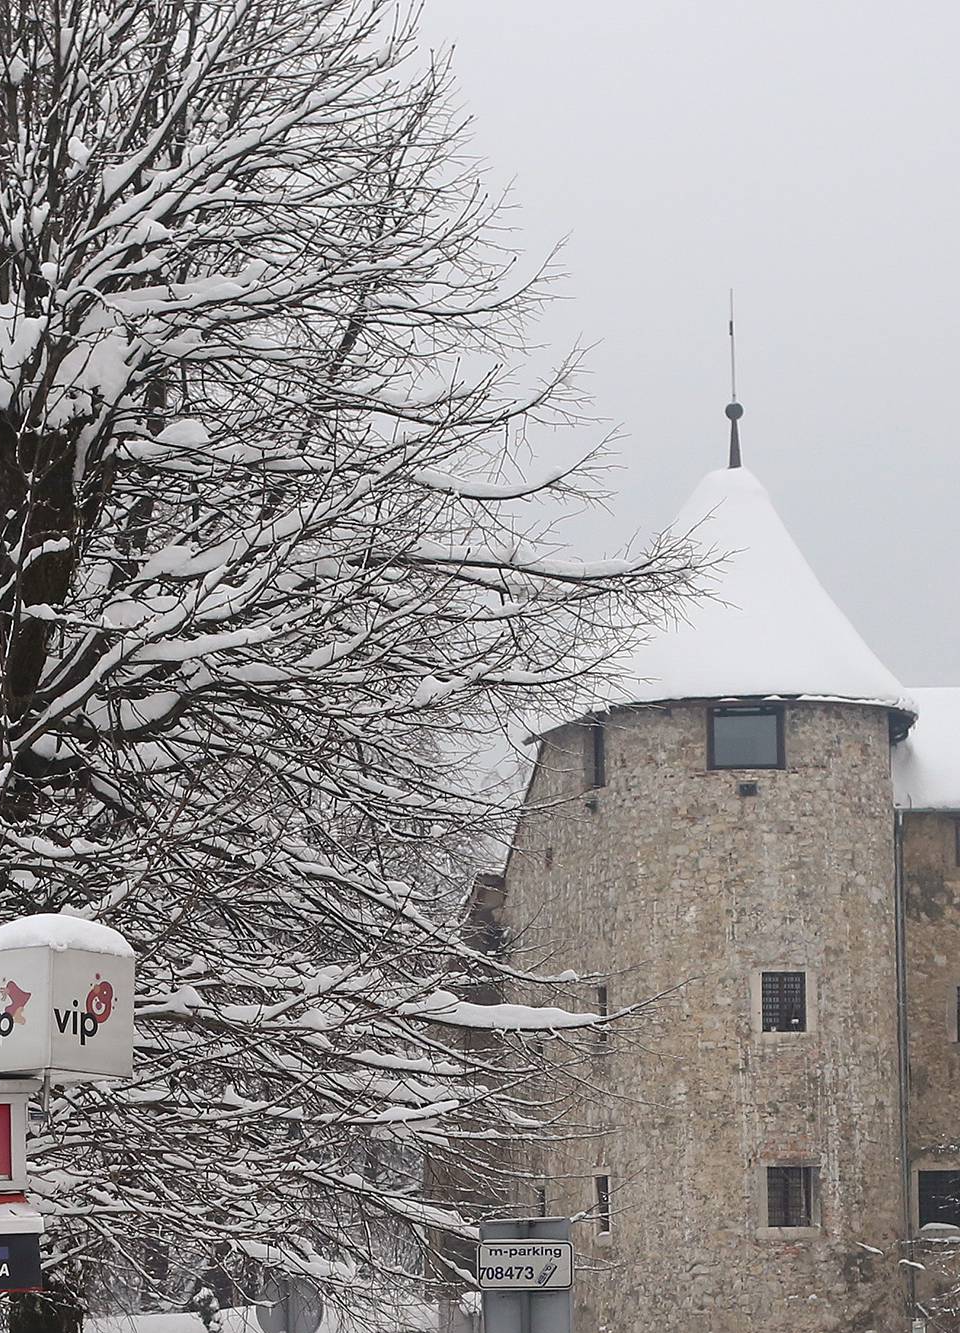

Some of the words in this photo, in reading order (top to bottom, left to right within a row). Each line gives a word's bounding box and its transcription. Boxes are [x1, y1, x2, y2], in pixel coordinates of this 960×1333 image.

[54, 1000, 98, 1045] vip
[489, 1246, 562, 1258] m-parking
[480, 1266, 534, 1280] 708473
